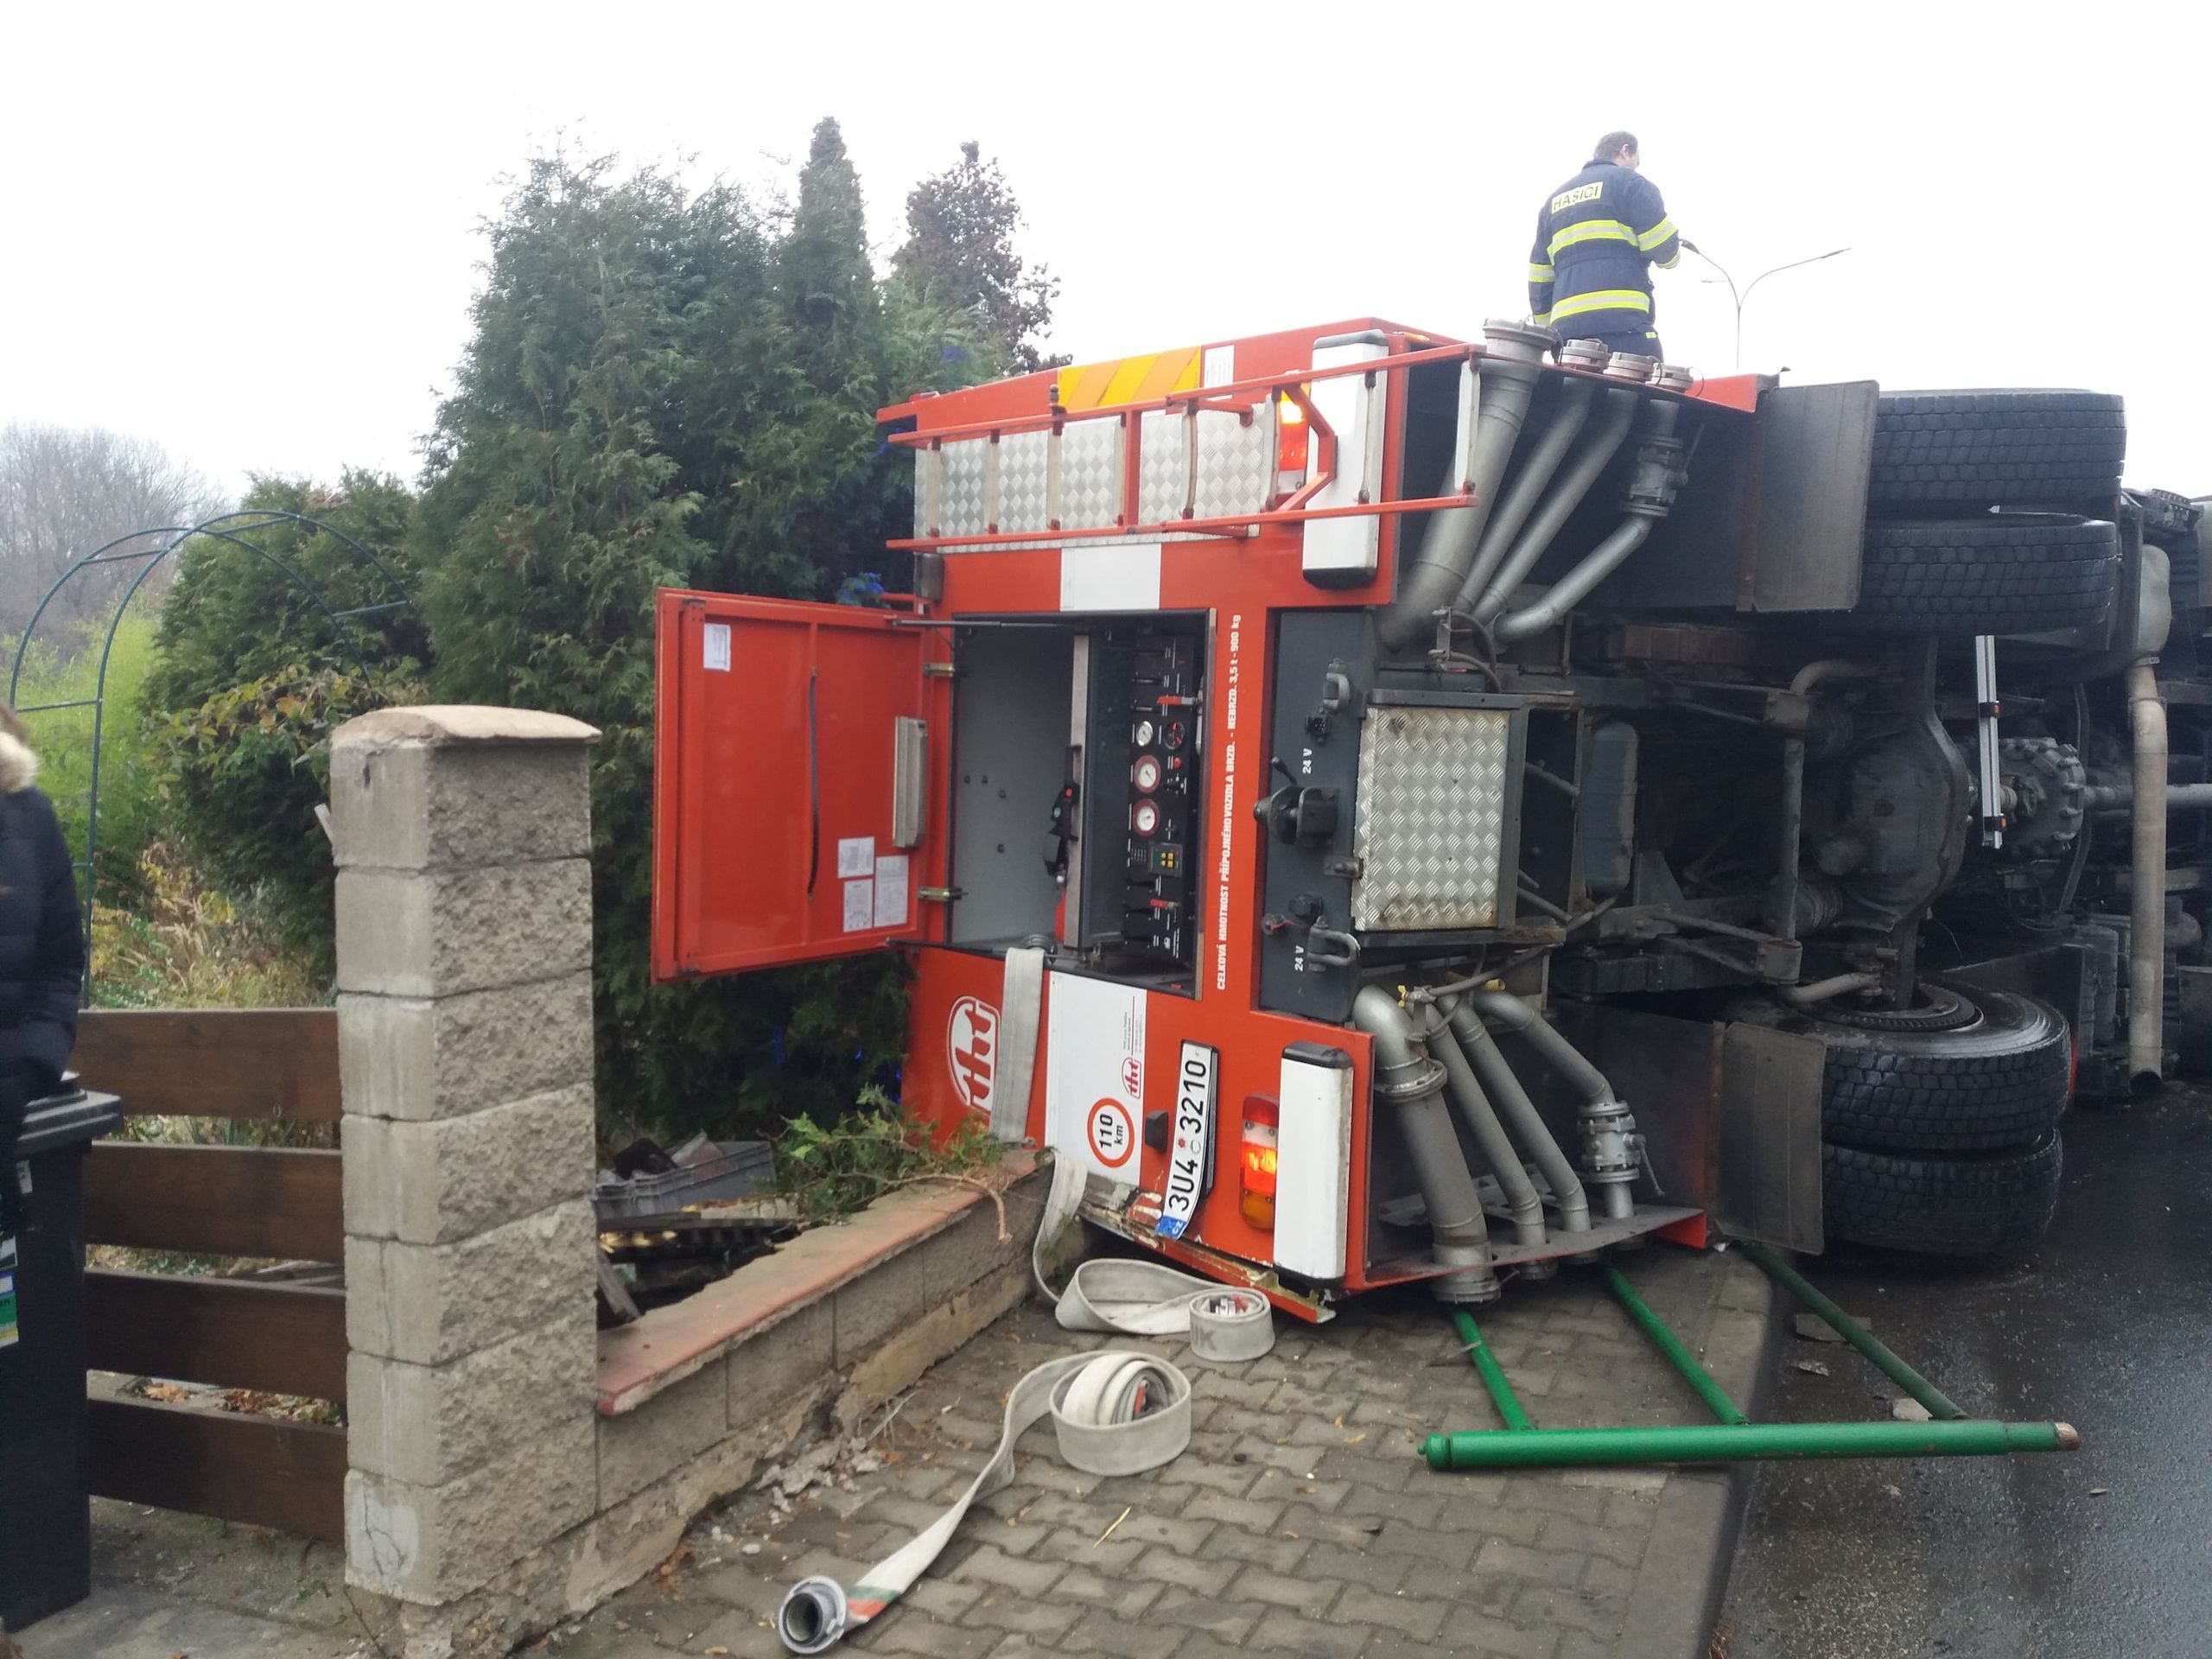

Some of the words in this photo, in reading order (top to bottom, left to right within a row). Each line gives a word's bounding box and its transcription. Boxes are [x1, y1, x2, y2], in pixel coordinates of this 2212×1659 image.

[1231, 614, 1242, 629] kg
[1230, 632, 1239, 652] 900
[1230, 666, 1239, 683] 3,5
[1228, 684, 1237, 729] NEBRZD.
[1226, 741, 1236, 772] BRZD.
[1303, 747, 1313, 757] V
[1302, 759, 1312, 774] 24
[1224, 774, 1235, 817] VOZIDLA
[1219, 817, 1233, 881] PŘÍPOJNÉHO
[1219, 885, 1230, 941] HMOTNOST
[1295, 944, 1304, 954] V
[1217, 944, 1227, 990] CELKOVÁ
[1294, 957, 1304, 972] 24
[1179, 1059, 1207, 1135] 3210
[1099, 1113, 1113, 1149] 110
[1114, 1125, 1123, 1145] km
[1168, 1159, 1198, 1212] 3U4
[1172, 1221, 1184, 1235] CZ
